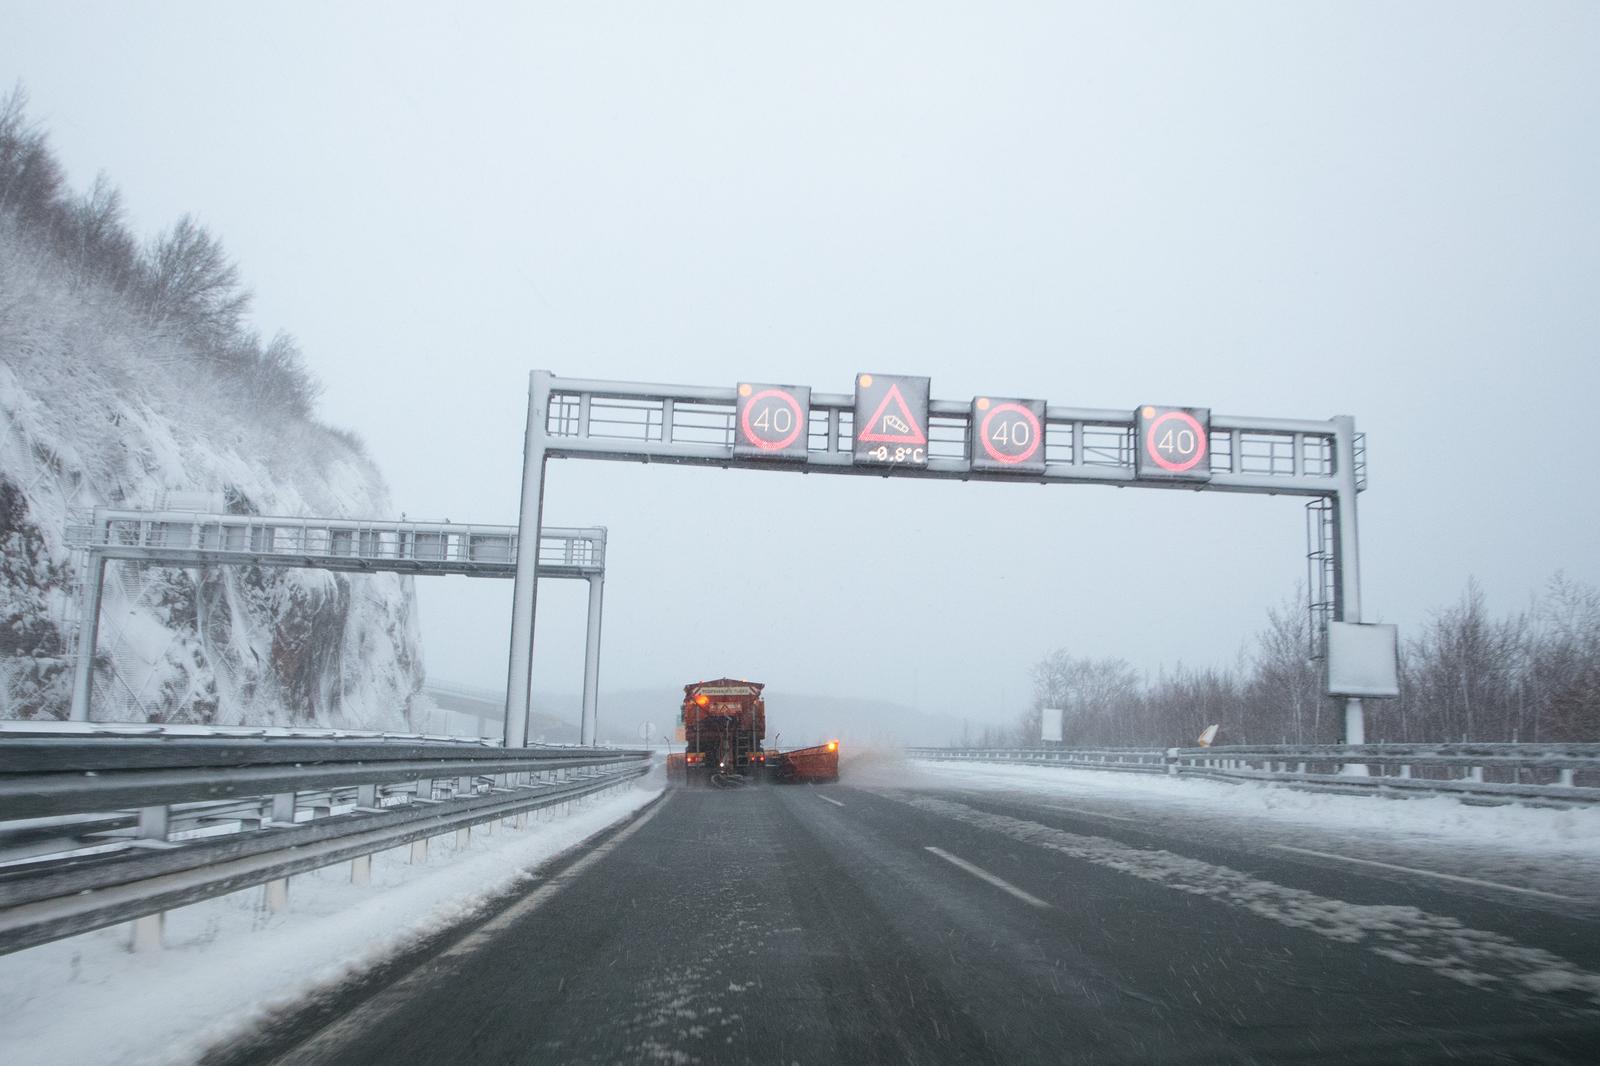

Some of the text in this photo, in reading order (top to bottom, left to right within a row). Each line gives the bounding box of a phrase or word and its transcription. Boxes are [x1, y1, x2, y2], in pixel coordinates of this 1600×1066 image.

[753, 407, 792, 433] 40
[992, 421, 1029, 446] 40
[1158, 429, 1195, 454] 40
